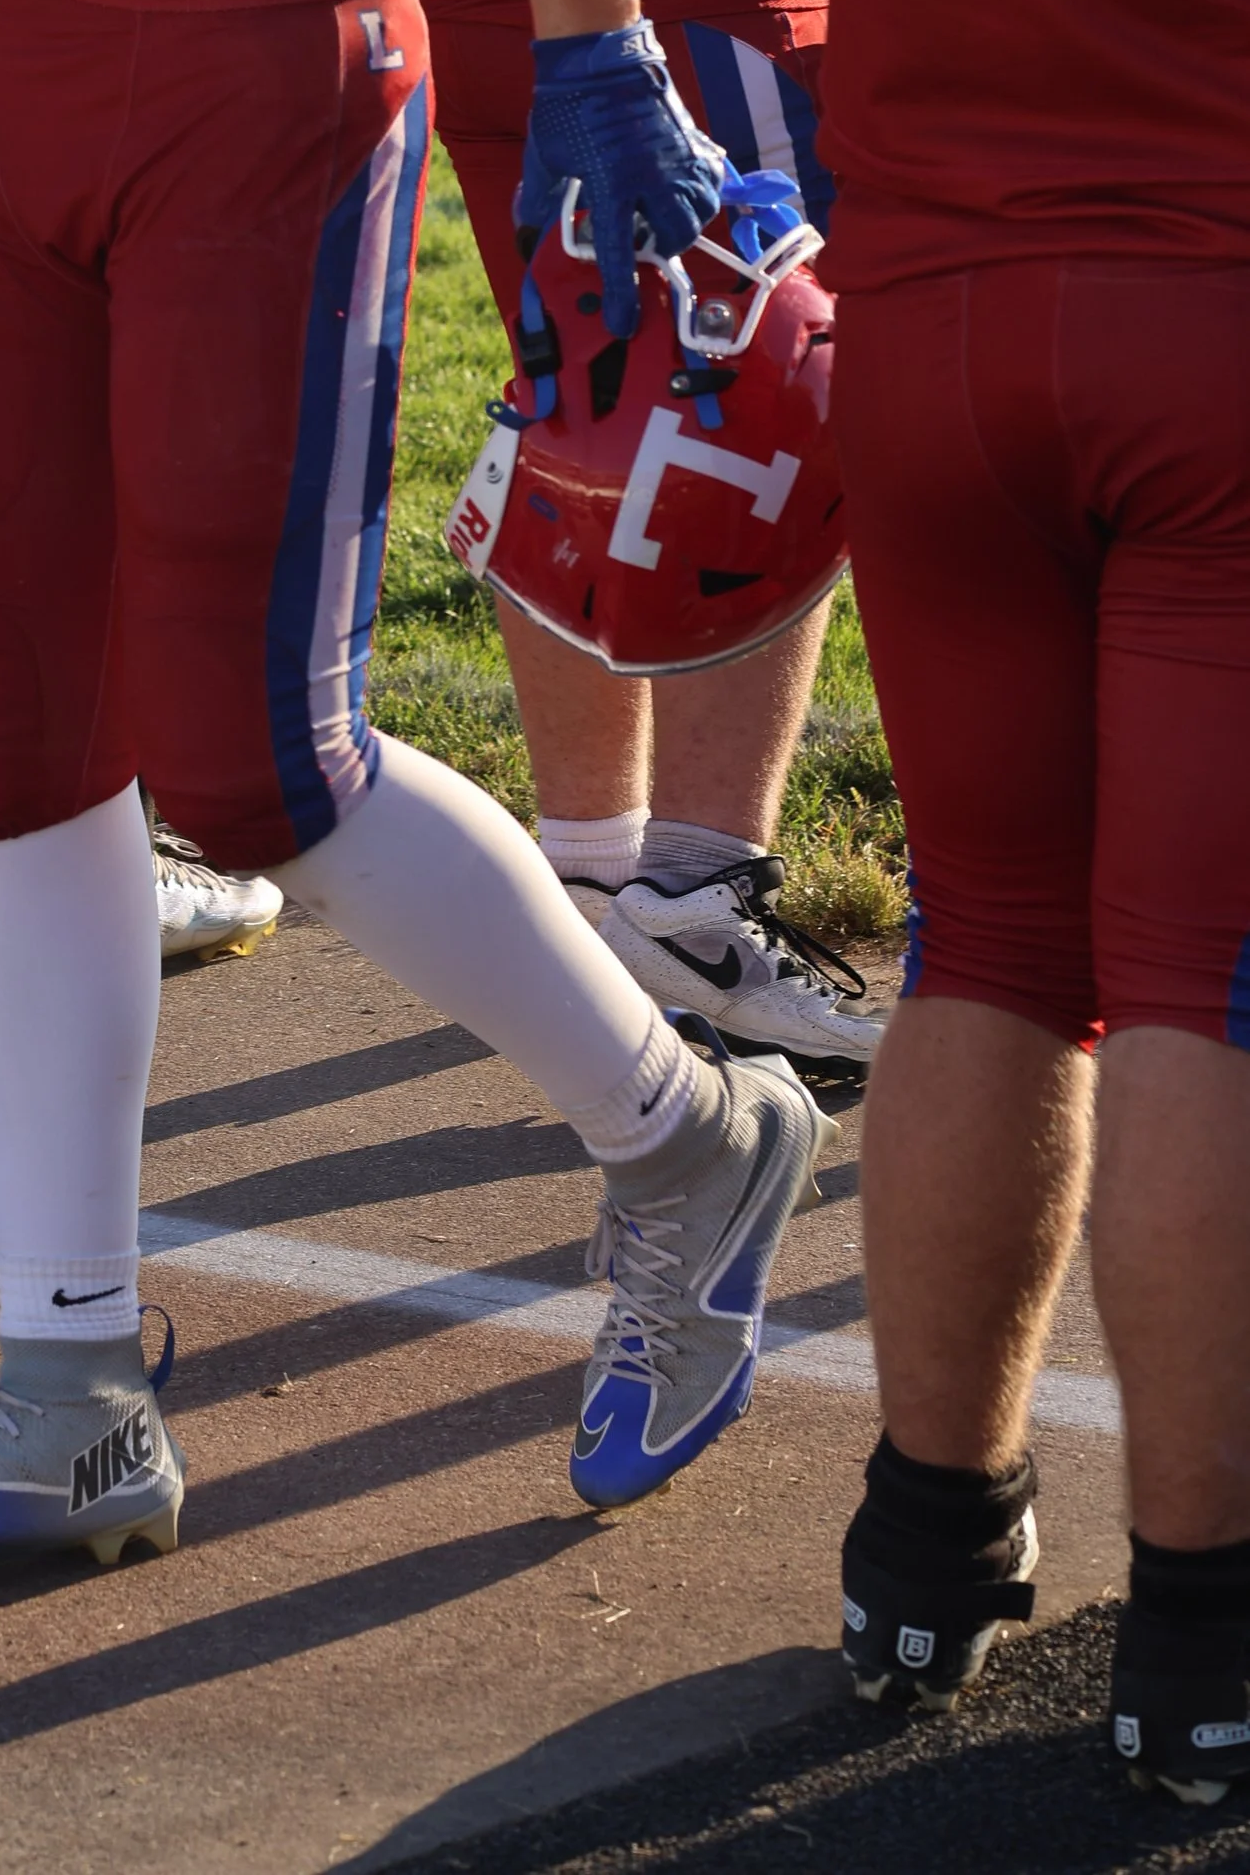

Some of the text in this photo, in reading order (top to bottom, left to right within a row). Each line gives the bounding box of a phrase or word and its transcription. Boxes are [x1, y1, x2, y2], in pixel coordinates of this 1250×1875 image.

[358, 9, 405, 71] L
[607, 404, 802, 571] L
[68, 1401, 154, 1516] NIKE
